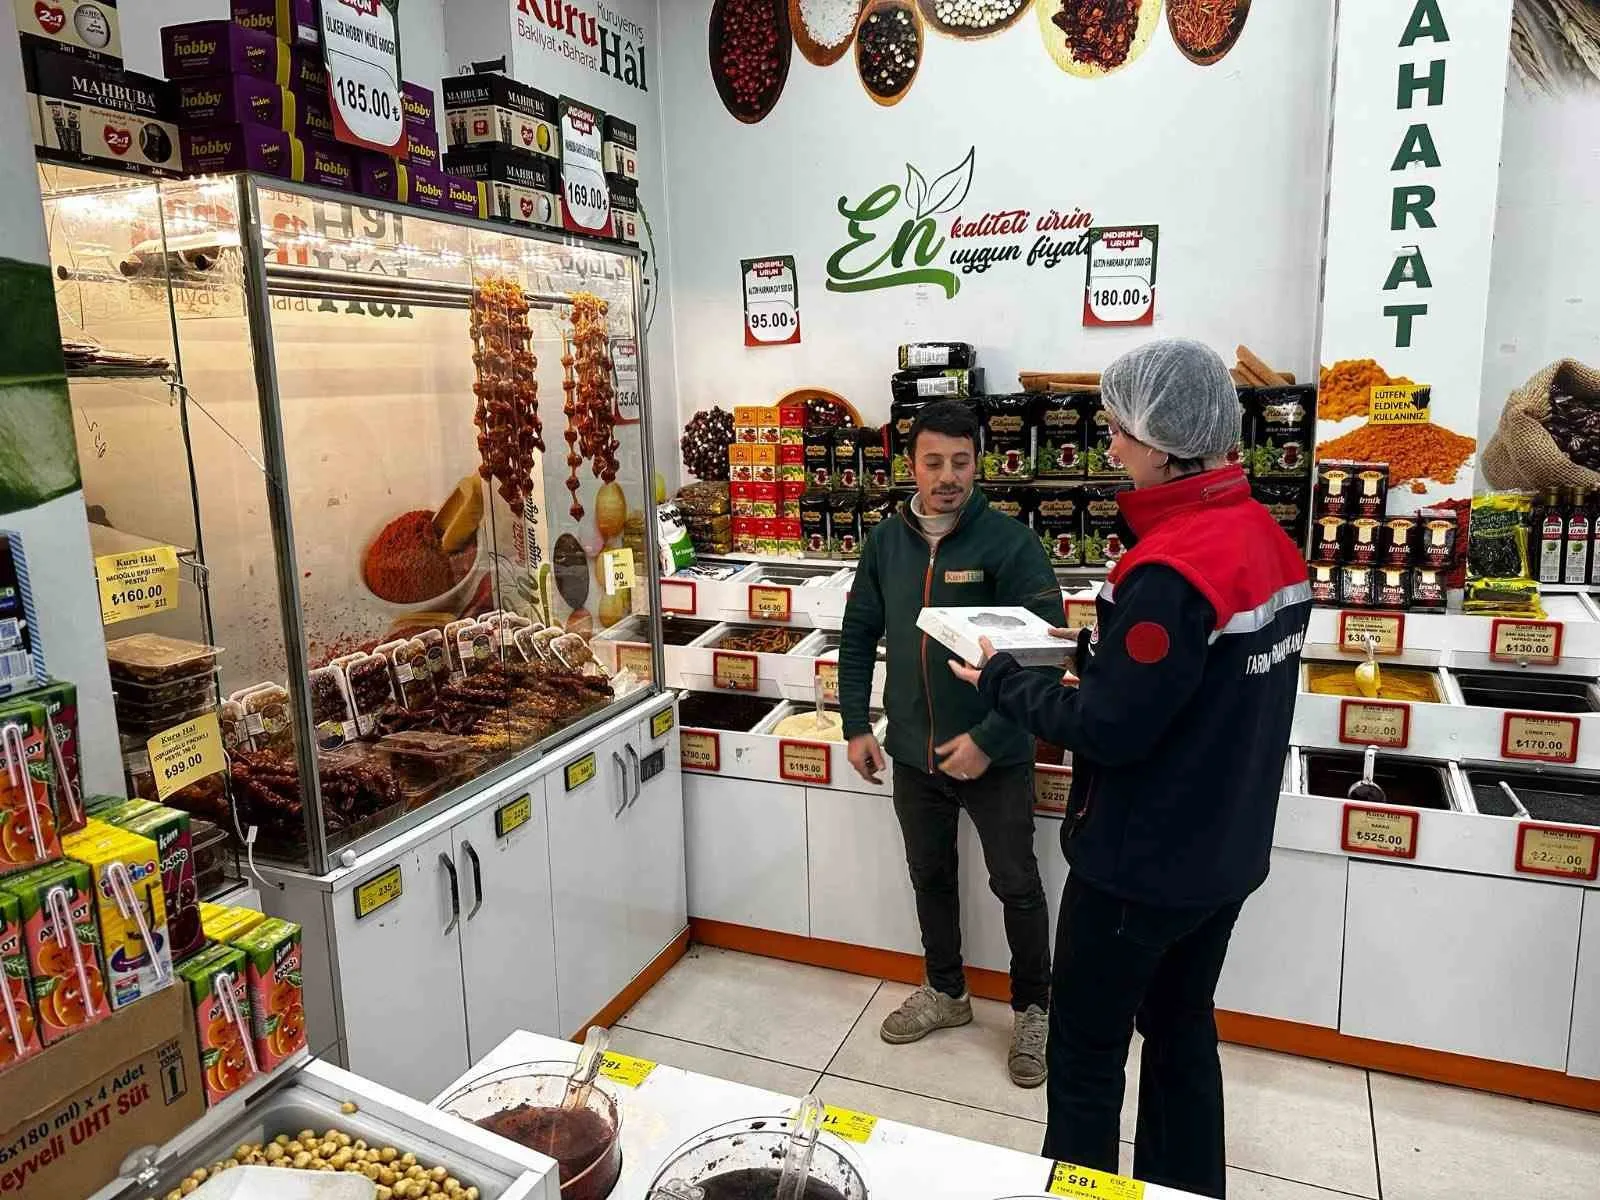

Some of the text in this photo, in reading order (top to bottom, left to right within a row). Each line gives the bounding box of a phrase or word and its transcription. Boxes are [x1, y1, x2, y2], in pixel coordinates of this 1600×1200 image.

[234, 13, 275, 29] hobby
[517, 0, 598, 47] Kuru
[174, 40, 217, 57] hobby
[518, 19, 598, 71] Bakliyat Baharat
[597, 24, 648, 92] Hâl
[72, 75, 157, 109] MAHBUBA
[181, 92, 222, 109] hobby
[446, 88, 489, 101] MAHBUBA
[98, 95, 136, 112] COFFEE
[507, 90, 545, 113] MAHBUBA
[191, 140, 232, 157] hobby
[408, 141, 437, 159] hobby
[315, 158, 350, 178] hobby
[506, 165, 546, 184] MAHBUBA
[416, 181, 443, 199] hobby
[450, 187, 478, 204] hobby
[950, 207, 1094, 239] kaliteli ürün
[826, 184, 946, 281] En
[950, 238, 1021, 274] uygun
[116, 558, 138, 567] Kuru
[112, 584, 162, 605] ₺160.00
[1505, 644, 1549, 653] ₺130.00
[161, 733, 181, 744] Kuru
[1516, 739, 1562, 749] ₺170.00
[165, 753, 202, 779] ₺99.00
[1357, 831, 1402, 845] ₺525.00
[98, 1087, 107, 1100] 4
[112, 1063, 145, 1093] Adet
[70, 1104, 112, 1146] UHT
[117, 1083, 151, 1116] Süt
